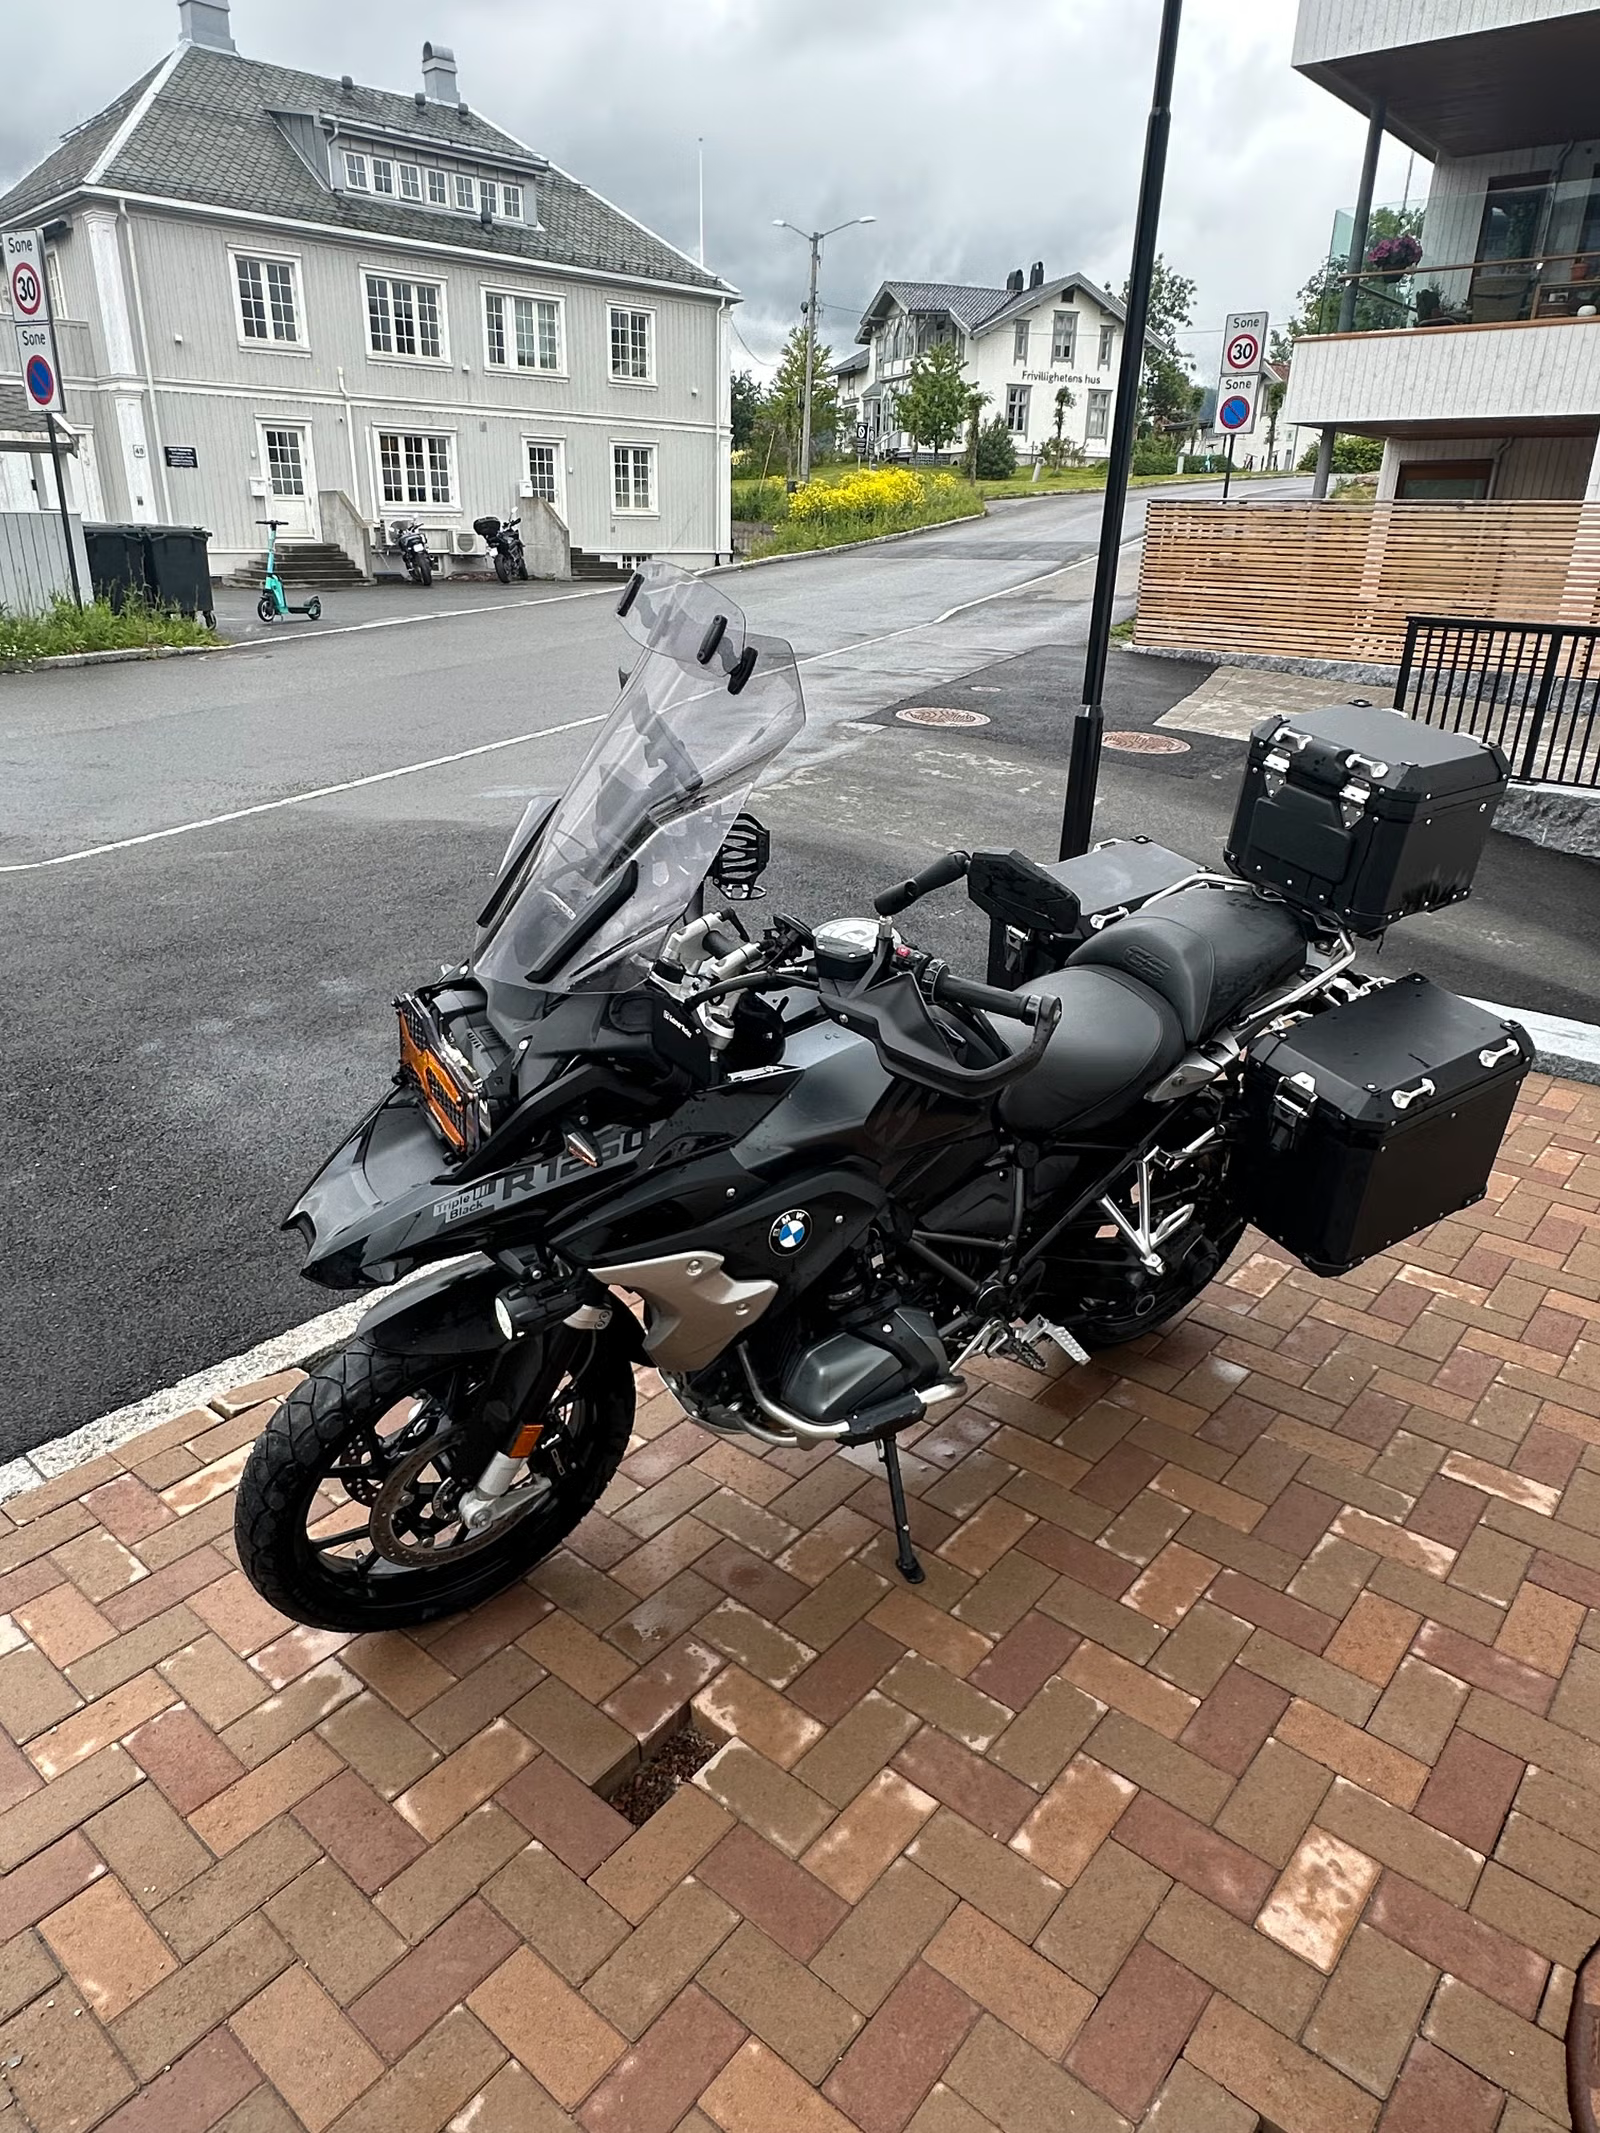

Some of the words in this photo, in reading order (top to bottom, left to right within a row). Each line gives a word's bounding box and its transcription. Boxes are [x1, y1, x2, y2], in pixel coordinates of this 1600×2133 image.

[8, 237, 33, 253] Sone
[17, 275, 36, 302] 30
[1233, 317, 1260, 329] Sone
[22, 330, 46, 346] Sone
[1232, 343, 1253, 360] 30
[1022, 370, 1083, 384] Frivillighetens
[1085, 374, 1101, 385] hus
[1225, 379, 1252, 390] Sone
[435, 1195, 471, 1213] Triple
[450, 1200, 483, 1220] Black
[772, 1211, 806, 1237] BMW
